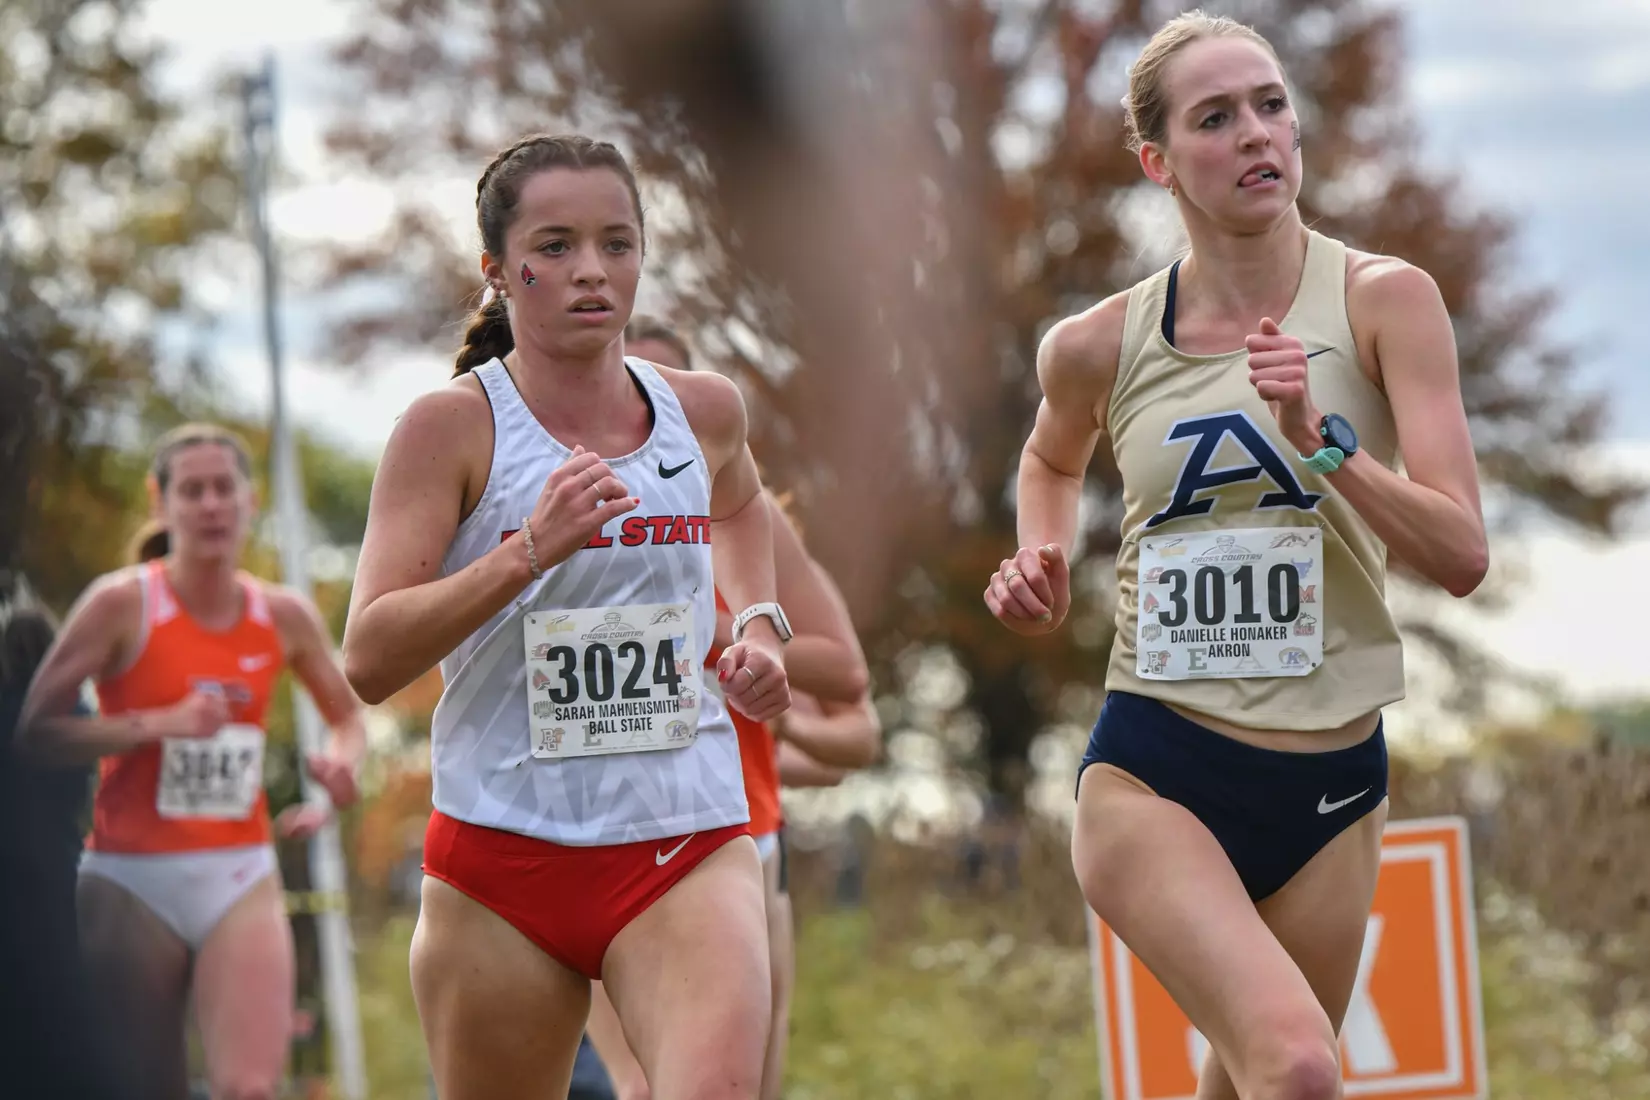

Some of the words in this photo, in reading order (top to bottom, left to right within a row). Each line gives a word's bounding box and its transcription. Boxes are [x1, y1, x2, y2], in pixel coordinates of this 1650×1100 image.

[1142, 409, 1328, 529] A
[1158, 563, 1300, 627] 3010
[1171, 628, 1226, 643] DANIELLE
[1230, 626, 1287, 642] HONAKER
[1208, 643, 1250, 658] AKRON
[546, 639, 682, 705] 3024
[555, 705, 595, 721] SARAH
[599, 700, 680, 718] MAHNENSMITH
[589, 720, 617, 735] BALL
[621, 717, 653, 732] STATE
